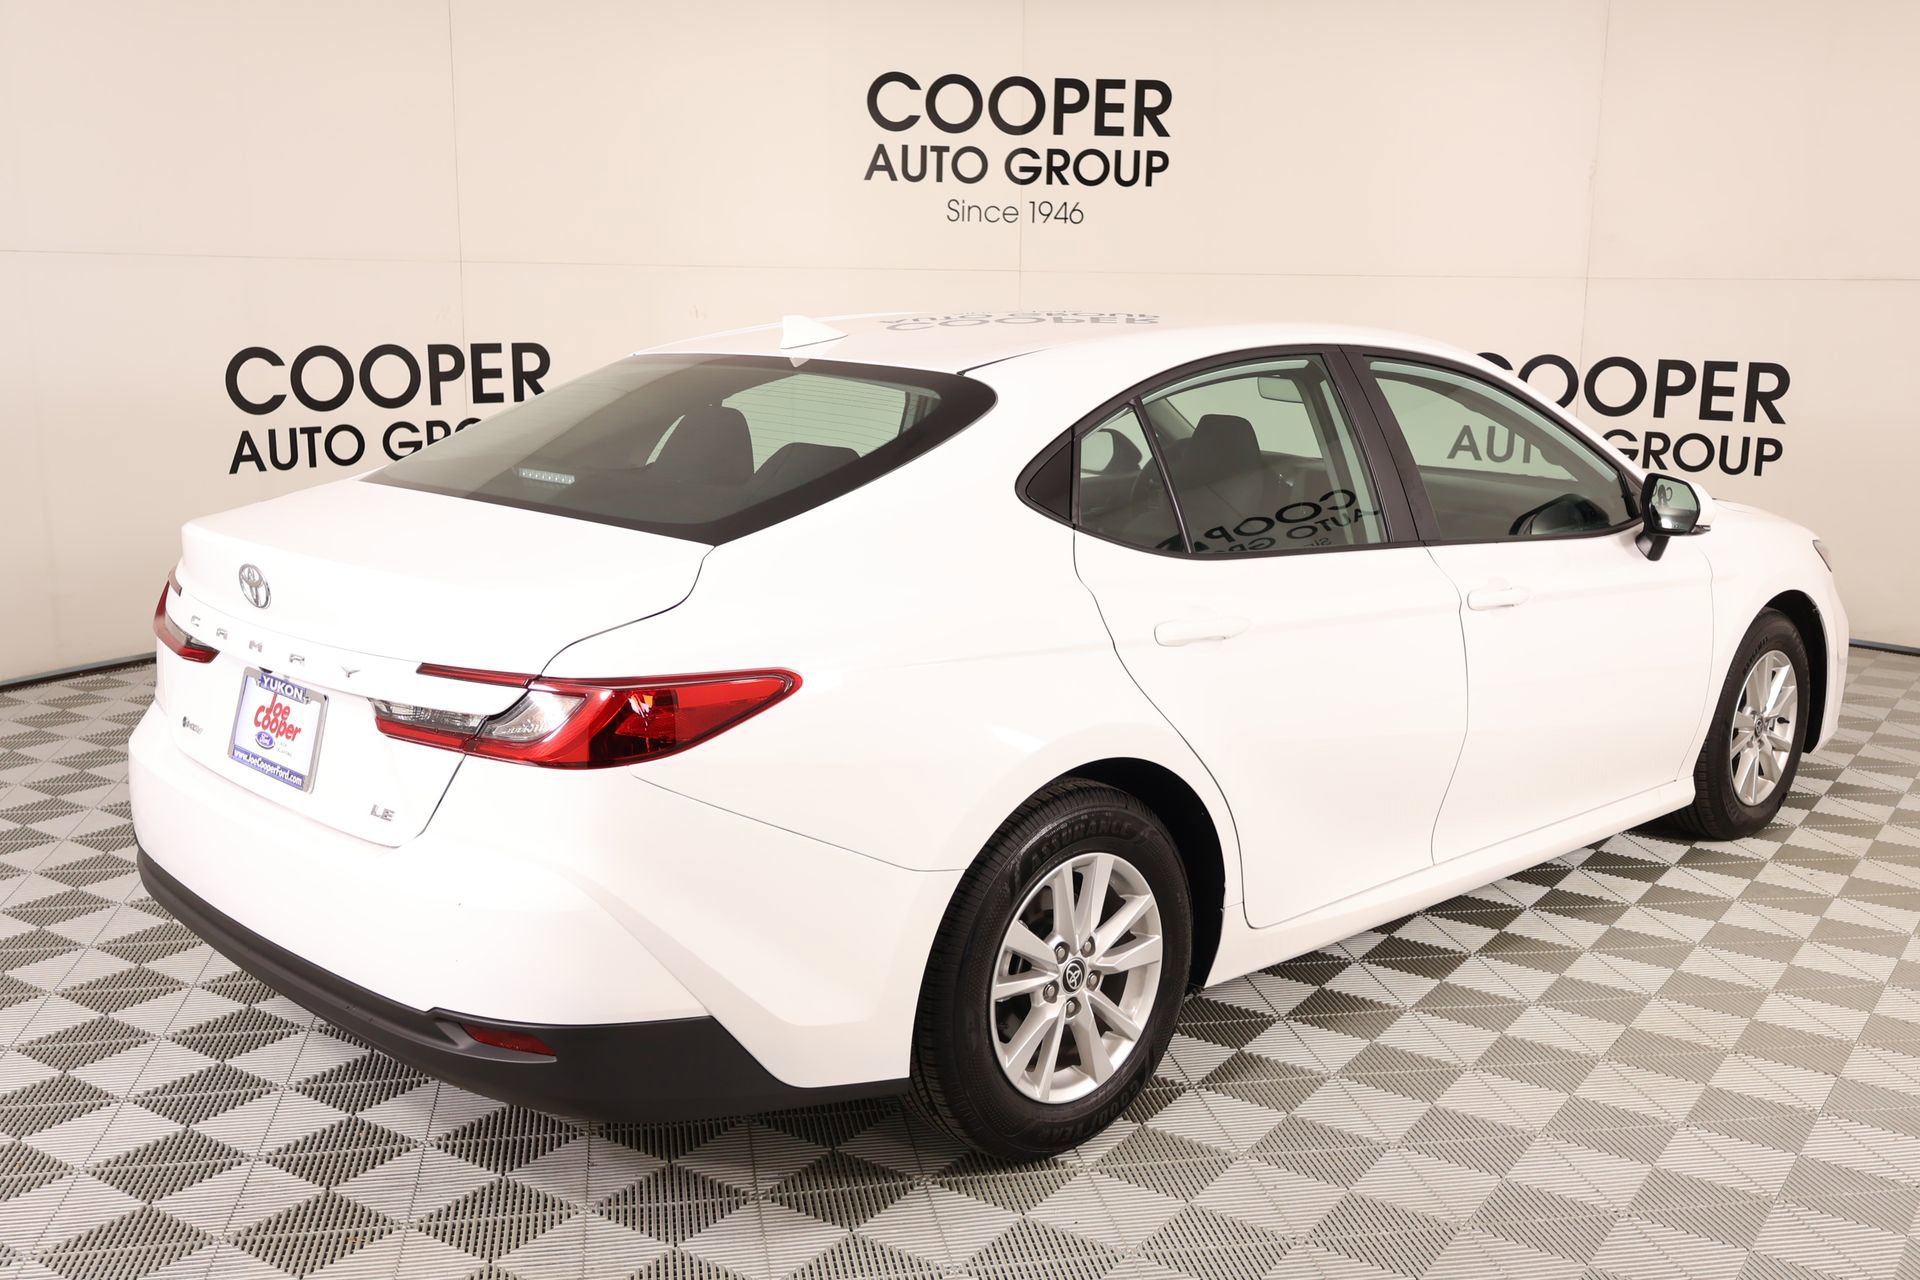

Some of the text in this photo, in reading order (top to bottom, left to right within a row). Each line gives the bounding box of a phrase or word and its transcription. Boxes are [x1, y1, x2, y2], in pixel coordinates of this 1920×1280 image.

[867, 71, 1173, 138] COOPER
[864, 143, 1170, 187] AUTO GROUP
[946, 198, 1085, 225] Since 1946
[225, 342, 551, 415] COOPER
[228, 424, 366, 475] AUTO
[1602, 428, 1783, 476] GROUP
[190, 614, 360, 679] CAMRY
[262, 674, 304, 701] YUKON
[265, 691, 291, 721] Joe
[253, 704, 302, 742] Cooper
[370, 804, 395, 822] LE
